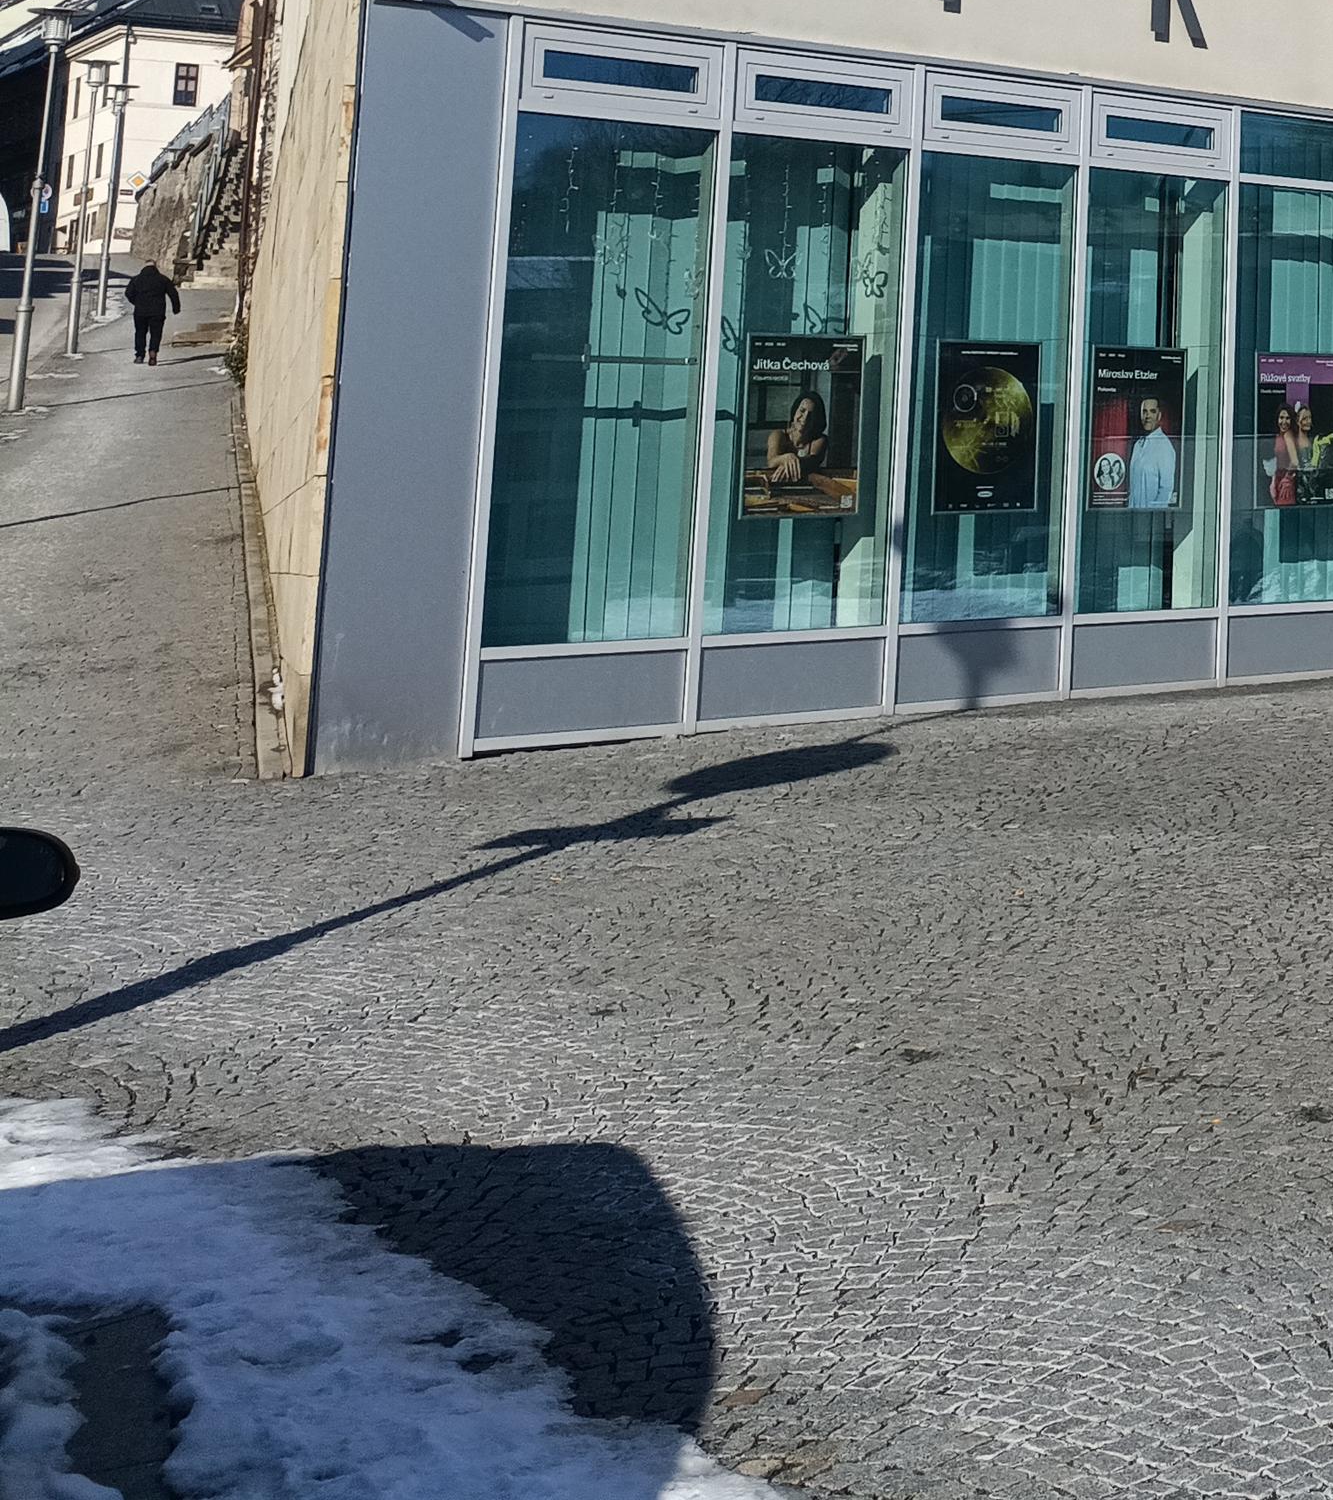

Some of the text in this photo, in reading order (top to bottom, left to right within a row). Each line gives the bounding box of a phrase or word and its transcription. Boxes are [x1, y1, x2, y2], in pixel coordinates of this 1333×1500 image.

[753, 357, 830, 370] Jitka Čechová
[1098, 368, 1158, 380] Miroslav Etzler
